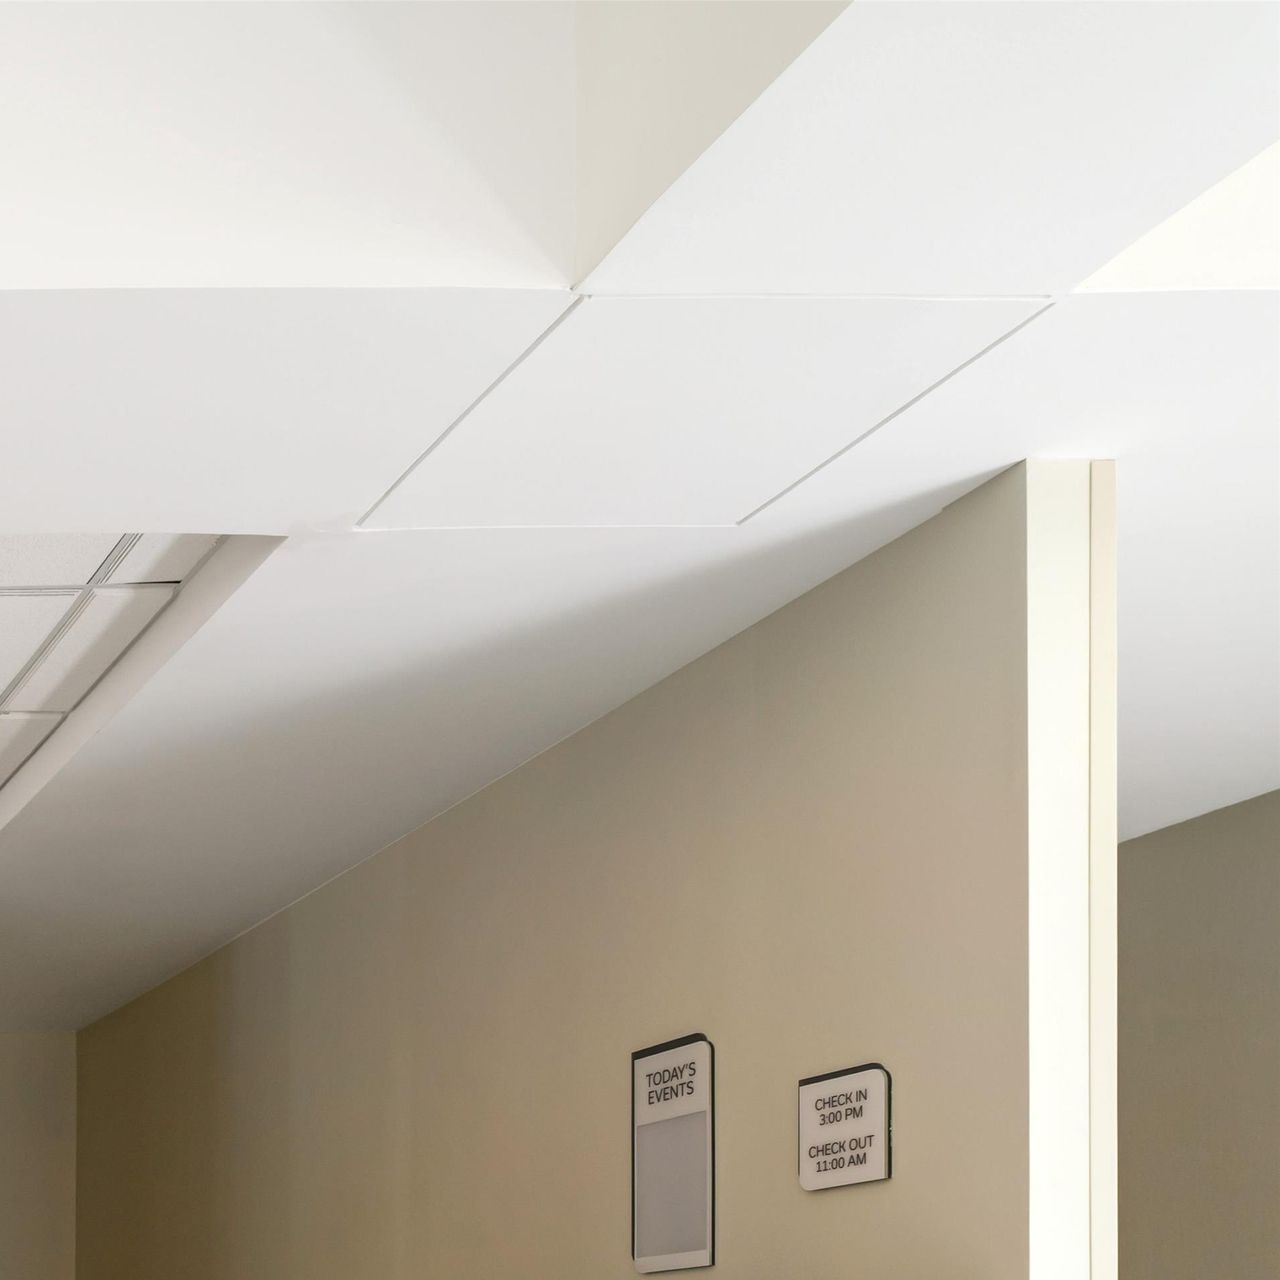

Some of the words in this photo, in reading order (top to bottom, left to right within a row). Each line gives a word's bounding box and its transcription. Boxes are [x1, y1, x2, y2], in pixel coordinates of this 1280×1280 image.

[646, 1061, 696, 1088] TODAY'S
[648, 1080, 695, 1105] EVENTS
[814, 1092, 853, 1111] CHECK
[855, 1088, 868, 1103] IN
[819, 1110, 842, 1126] 3:00
[844, 1105, 863, 1120] PM
[808, 1140, 846, 1158] CHECK
[848, 1134, 875, 1151] OUT
[816, 1156, 845, 1173] 11:00
[847, 1152, 867, 1167] AM
